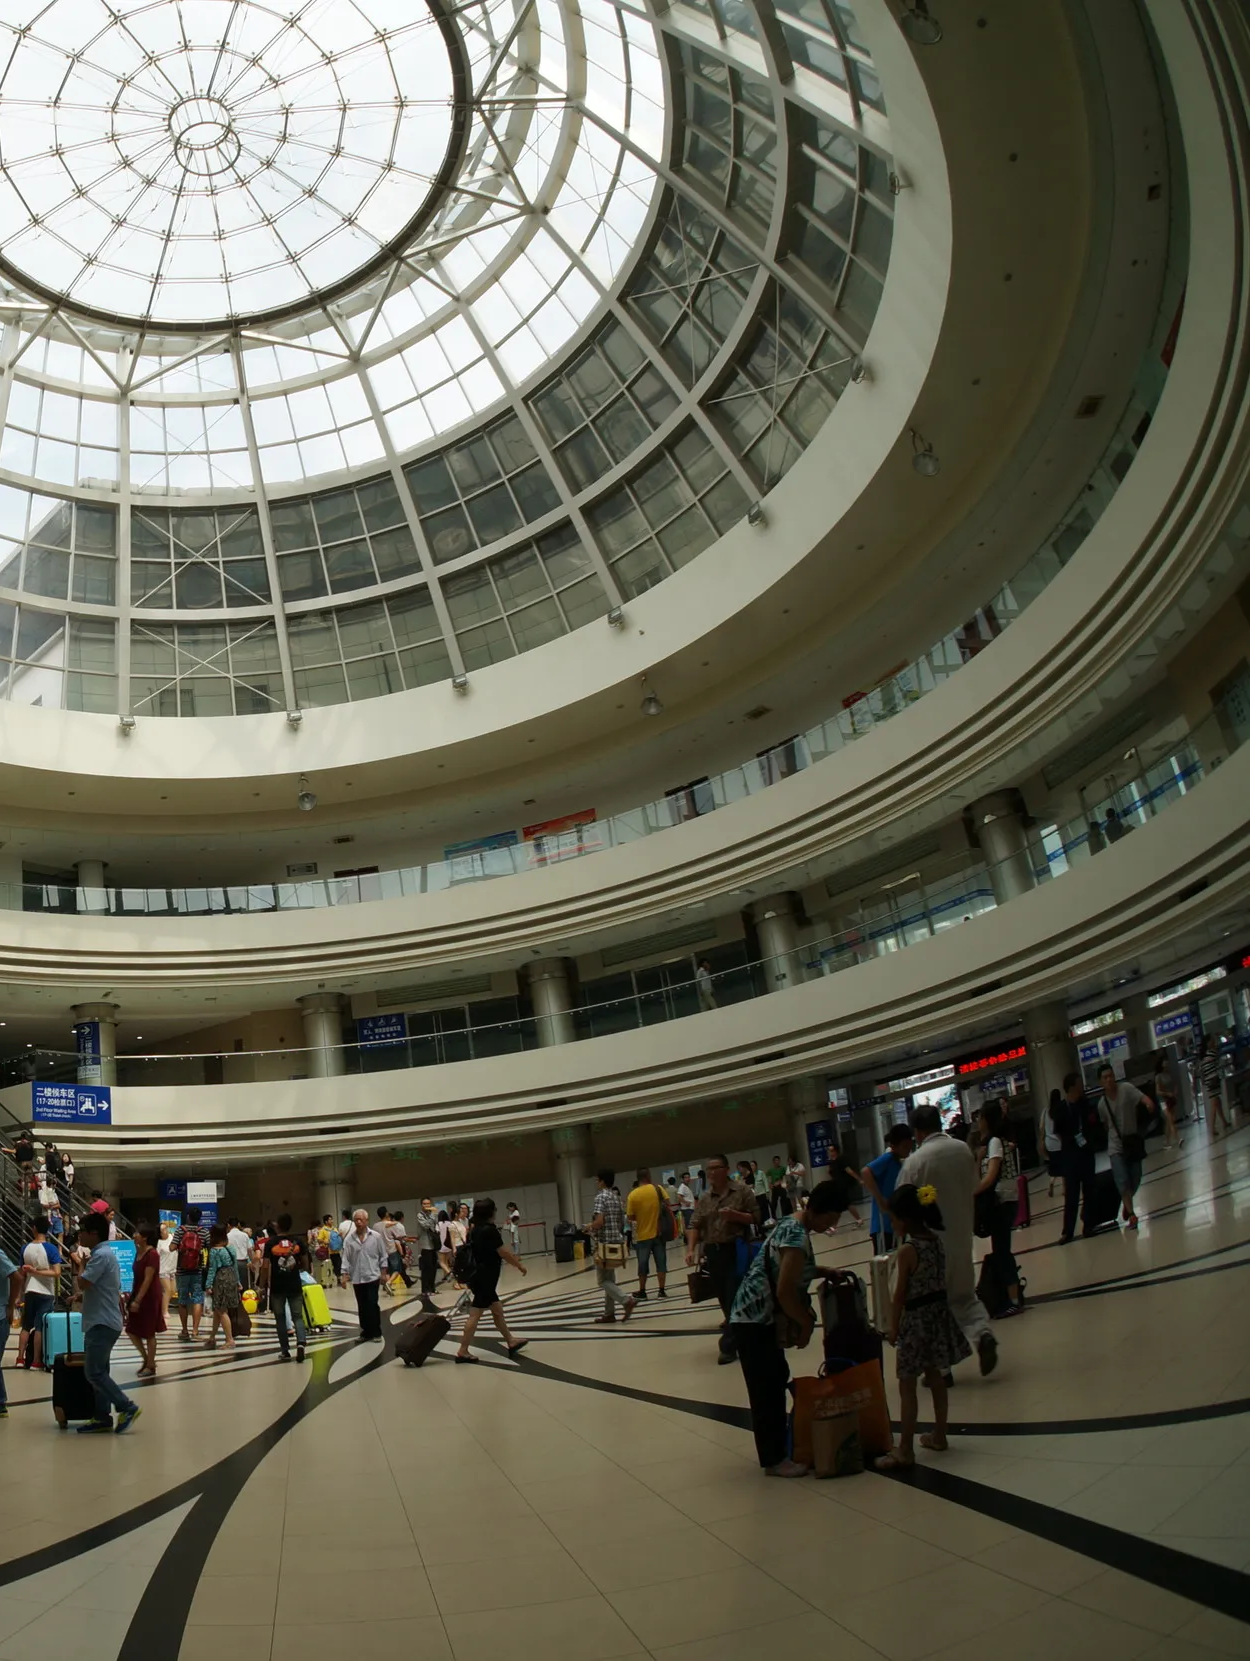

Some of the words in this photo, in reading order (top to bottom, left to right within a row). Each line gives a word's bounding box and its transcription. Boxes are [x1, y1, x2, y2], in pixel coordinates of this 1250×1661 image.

[1156, 1016, 1189, 1033] 广州办事处
[36, 1087, 75, 1098] 二楼候车区
